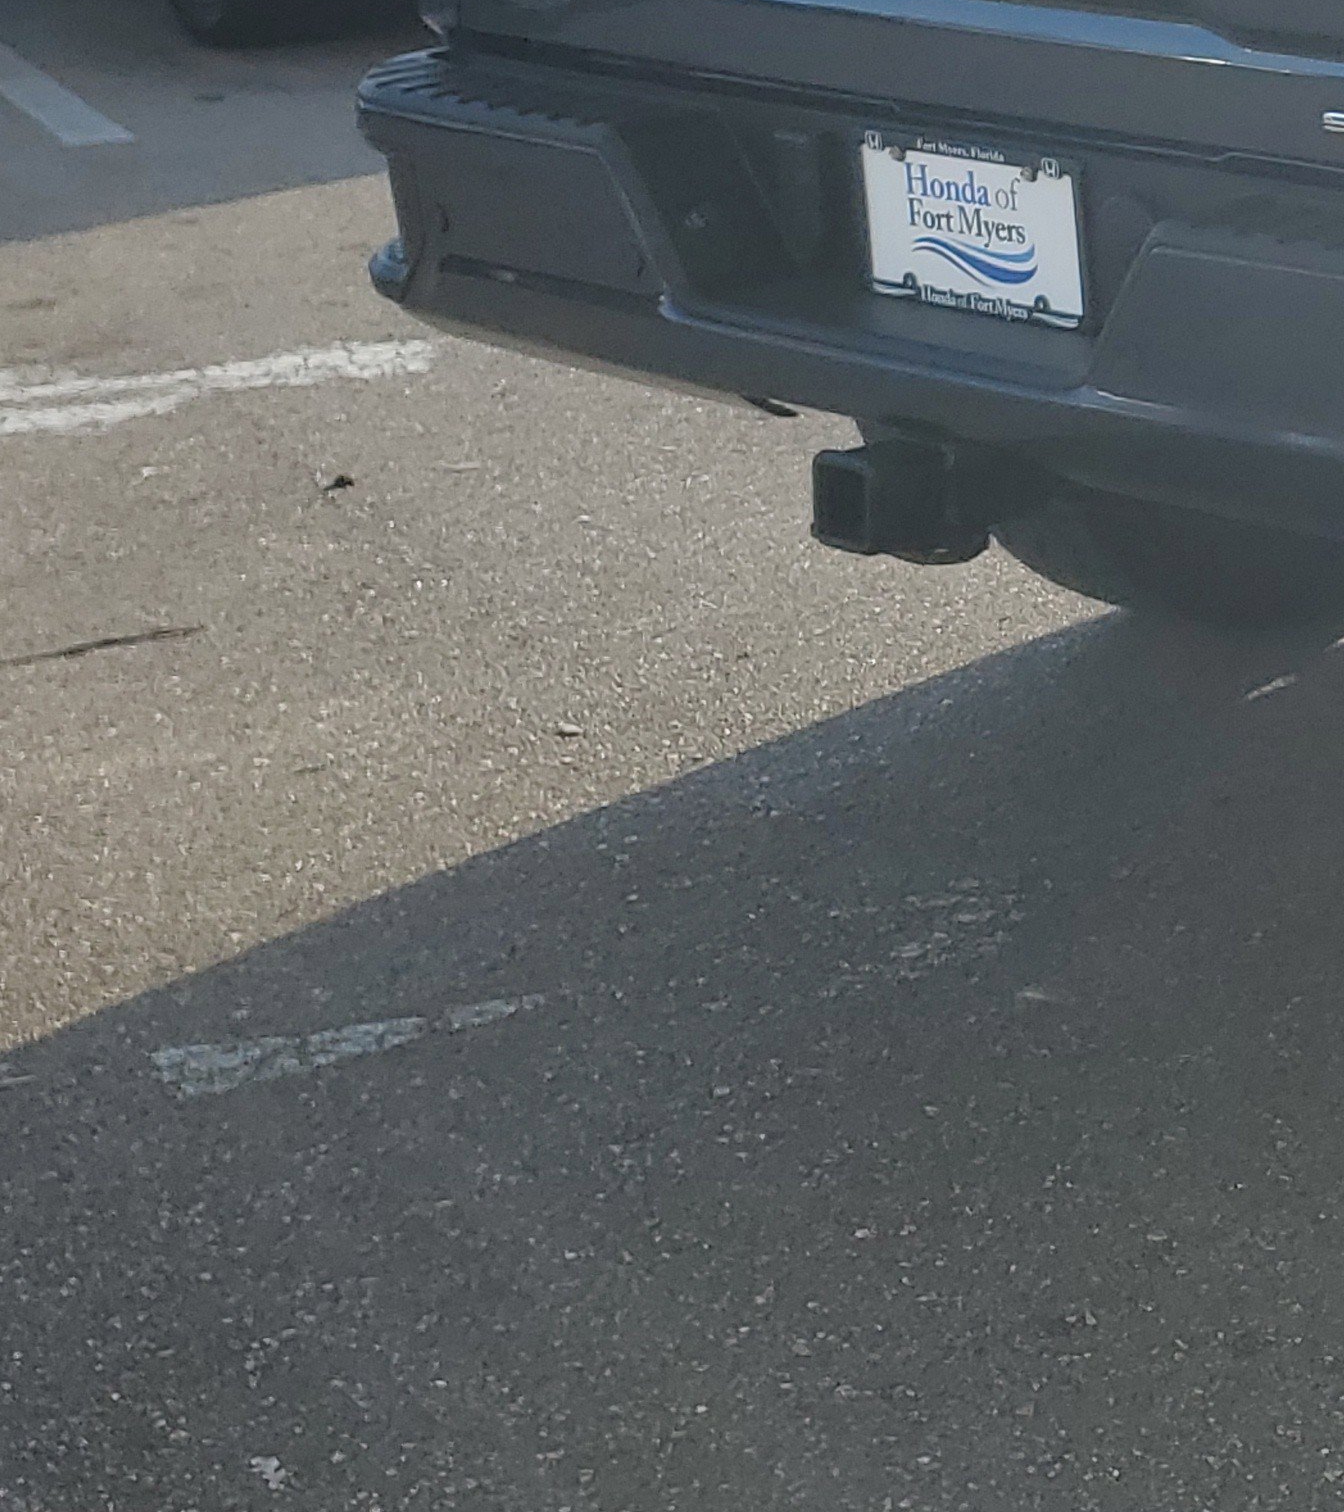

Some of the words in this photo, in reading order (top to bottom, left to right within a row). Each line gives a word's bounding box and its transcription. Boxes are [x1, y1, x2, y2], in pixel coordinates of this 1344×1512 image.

[904, 161, 991, 207] Honda
[995, 176, 1021, 211] of
[908, 197, 954, 233] Fort
[957, 204, 1026, 248] Myers
[920, 285, 957, 306] Honda
